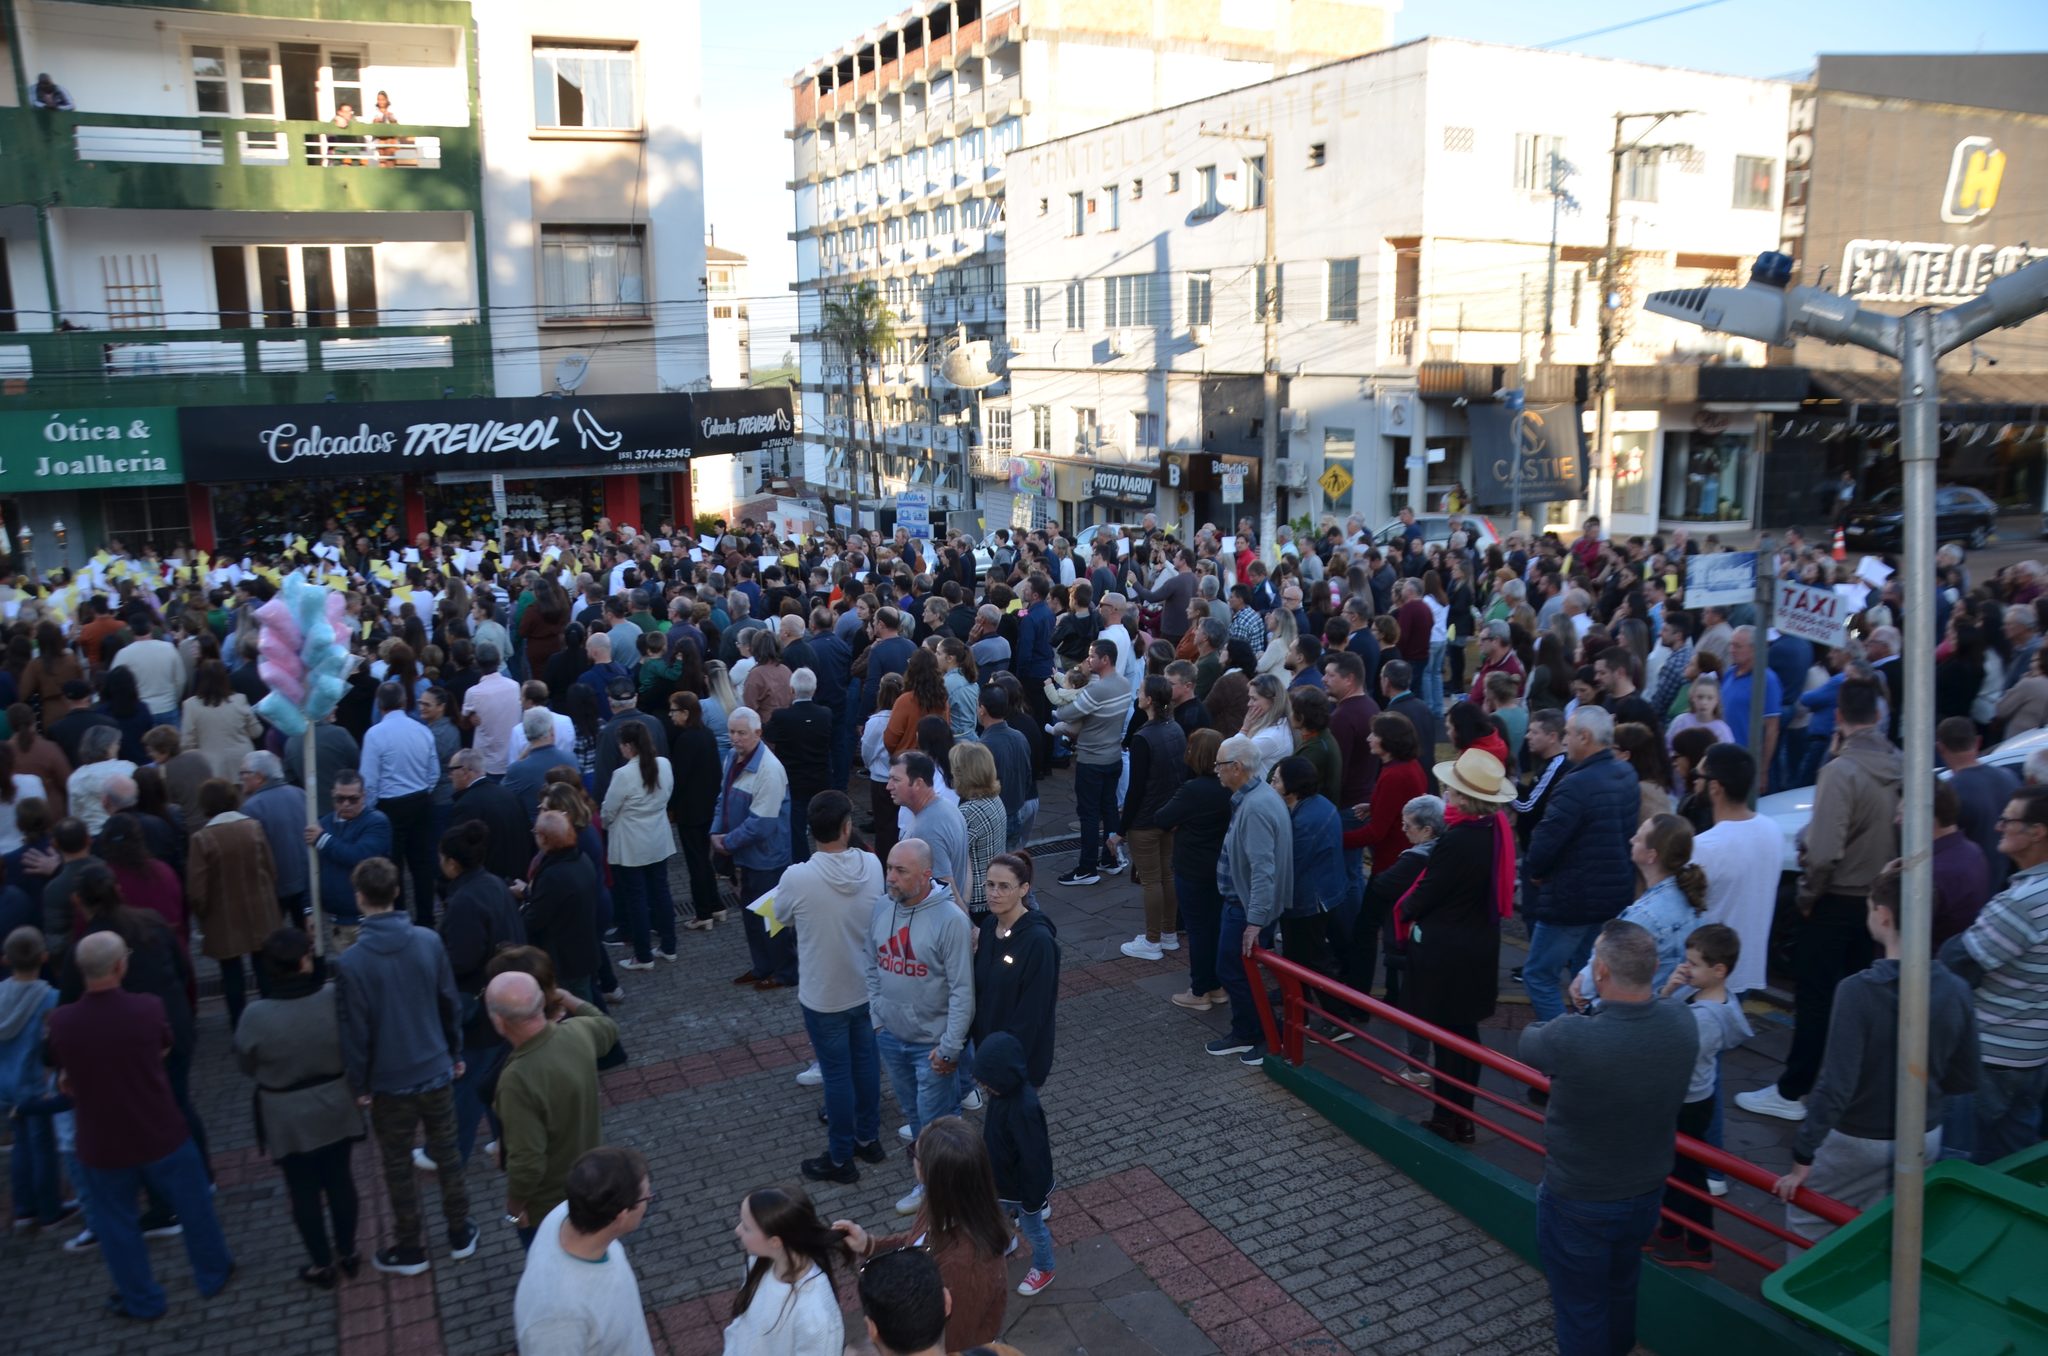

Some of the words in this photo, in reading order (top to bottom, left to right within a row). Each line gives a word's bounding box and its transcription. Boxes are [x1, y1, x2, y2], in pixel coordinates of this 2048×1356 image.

[43, 412, 122, 442] Ótica
[126, 419, 152, 440] &
[737, 413, 777, 436] TREVISOL
[259, 422, 397, 464] Calçados
[402, 415, 560, 457] TREVISOL
[33, 449, 168, 477] Joalheria
[634, 448, 691, 460] 3744-2945
[1094, 472, 1119, 490] FOTO
[1119, 475, 1153, 494] MARIN
[1783, 587, 1838, 618] TÁXI
[877, 954, 928, 977] adidas
